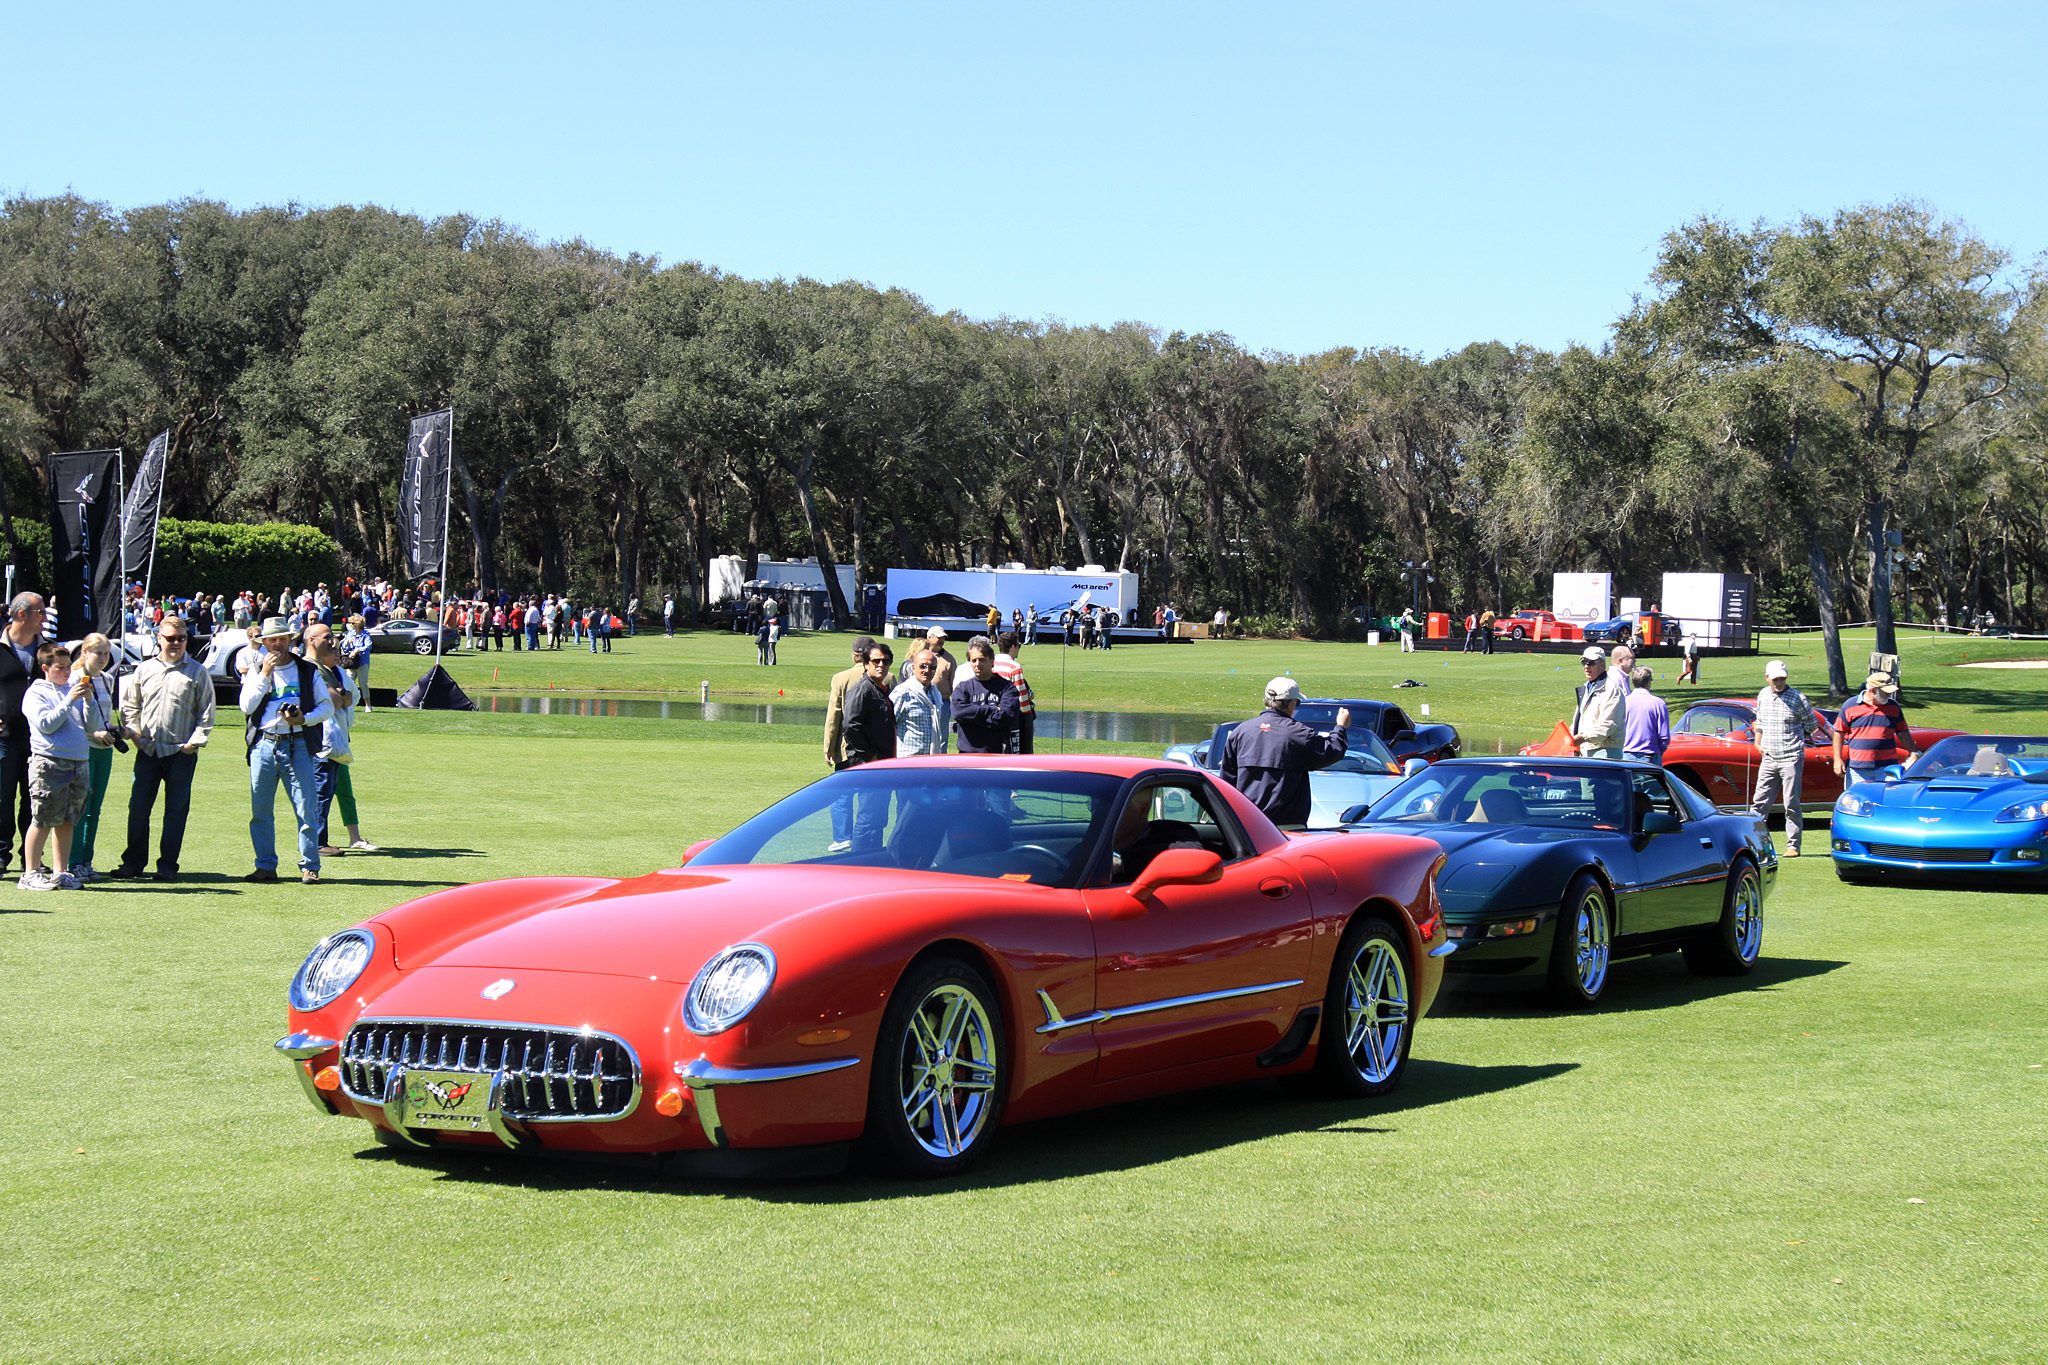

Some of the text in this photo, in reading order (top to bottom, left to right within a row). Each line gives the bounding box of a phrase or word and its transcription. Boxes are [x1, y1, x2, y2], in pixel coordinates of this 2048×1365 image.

[78, 502, 92, 622] CORVETTE
[412, 456, 422, 566] CORVETTE
[416, 1112, 482, 1123] CORVETTE
